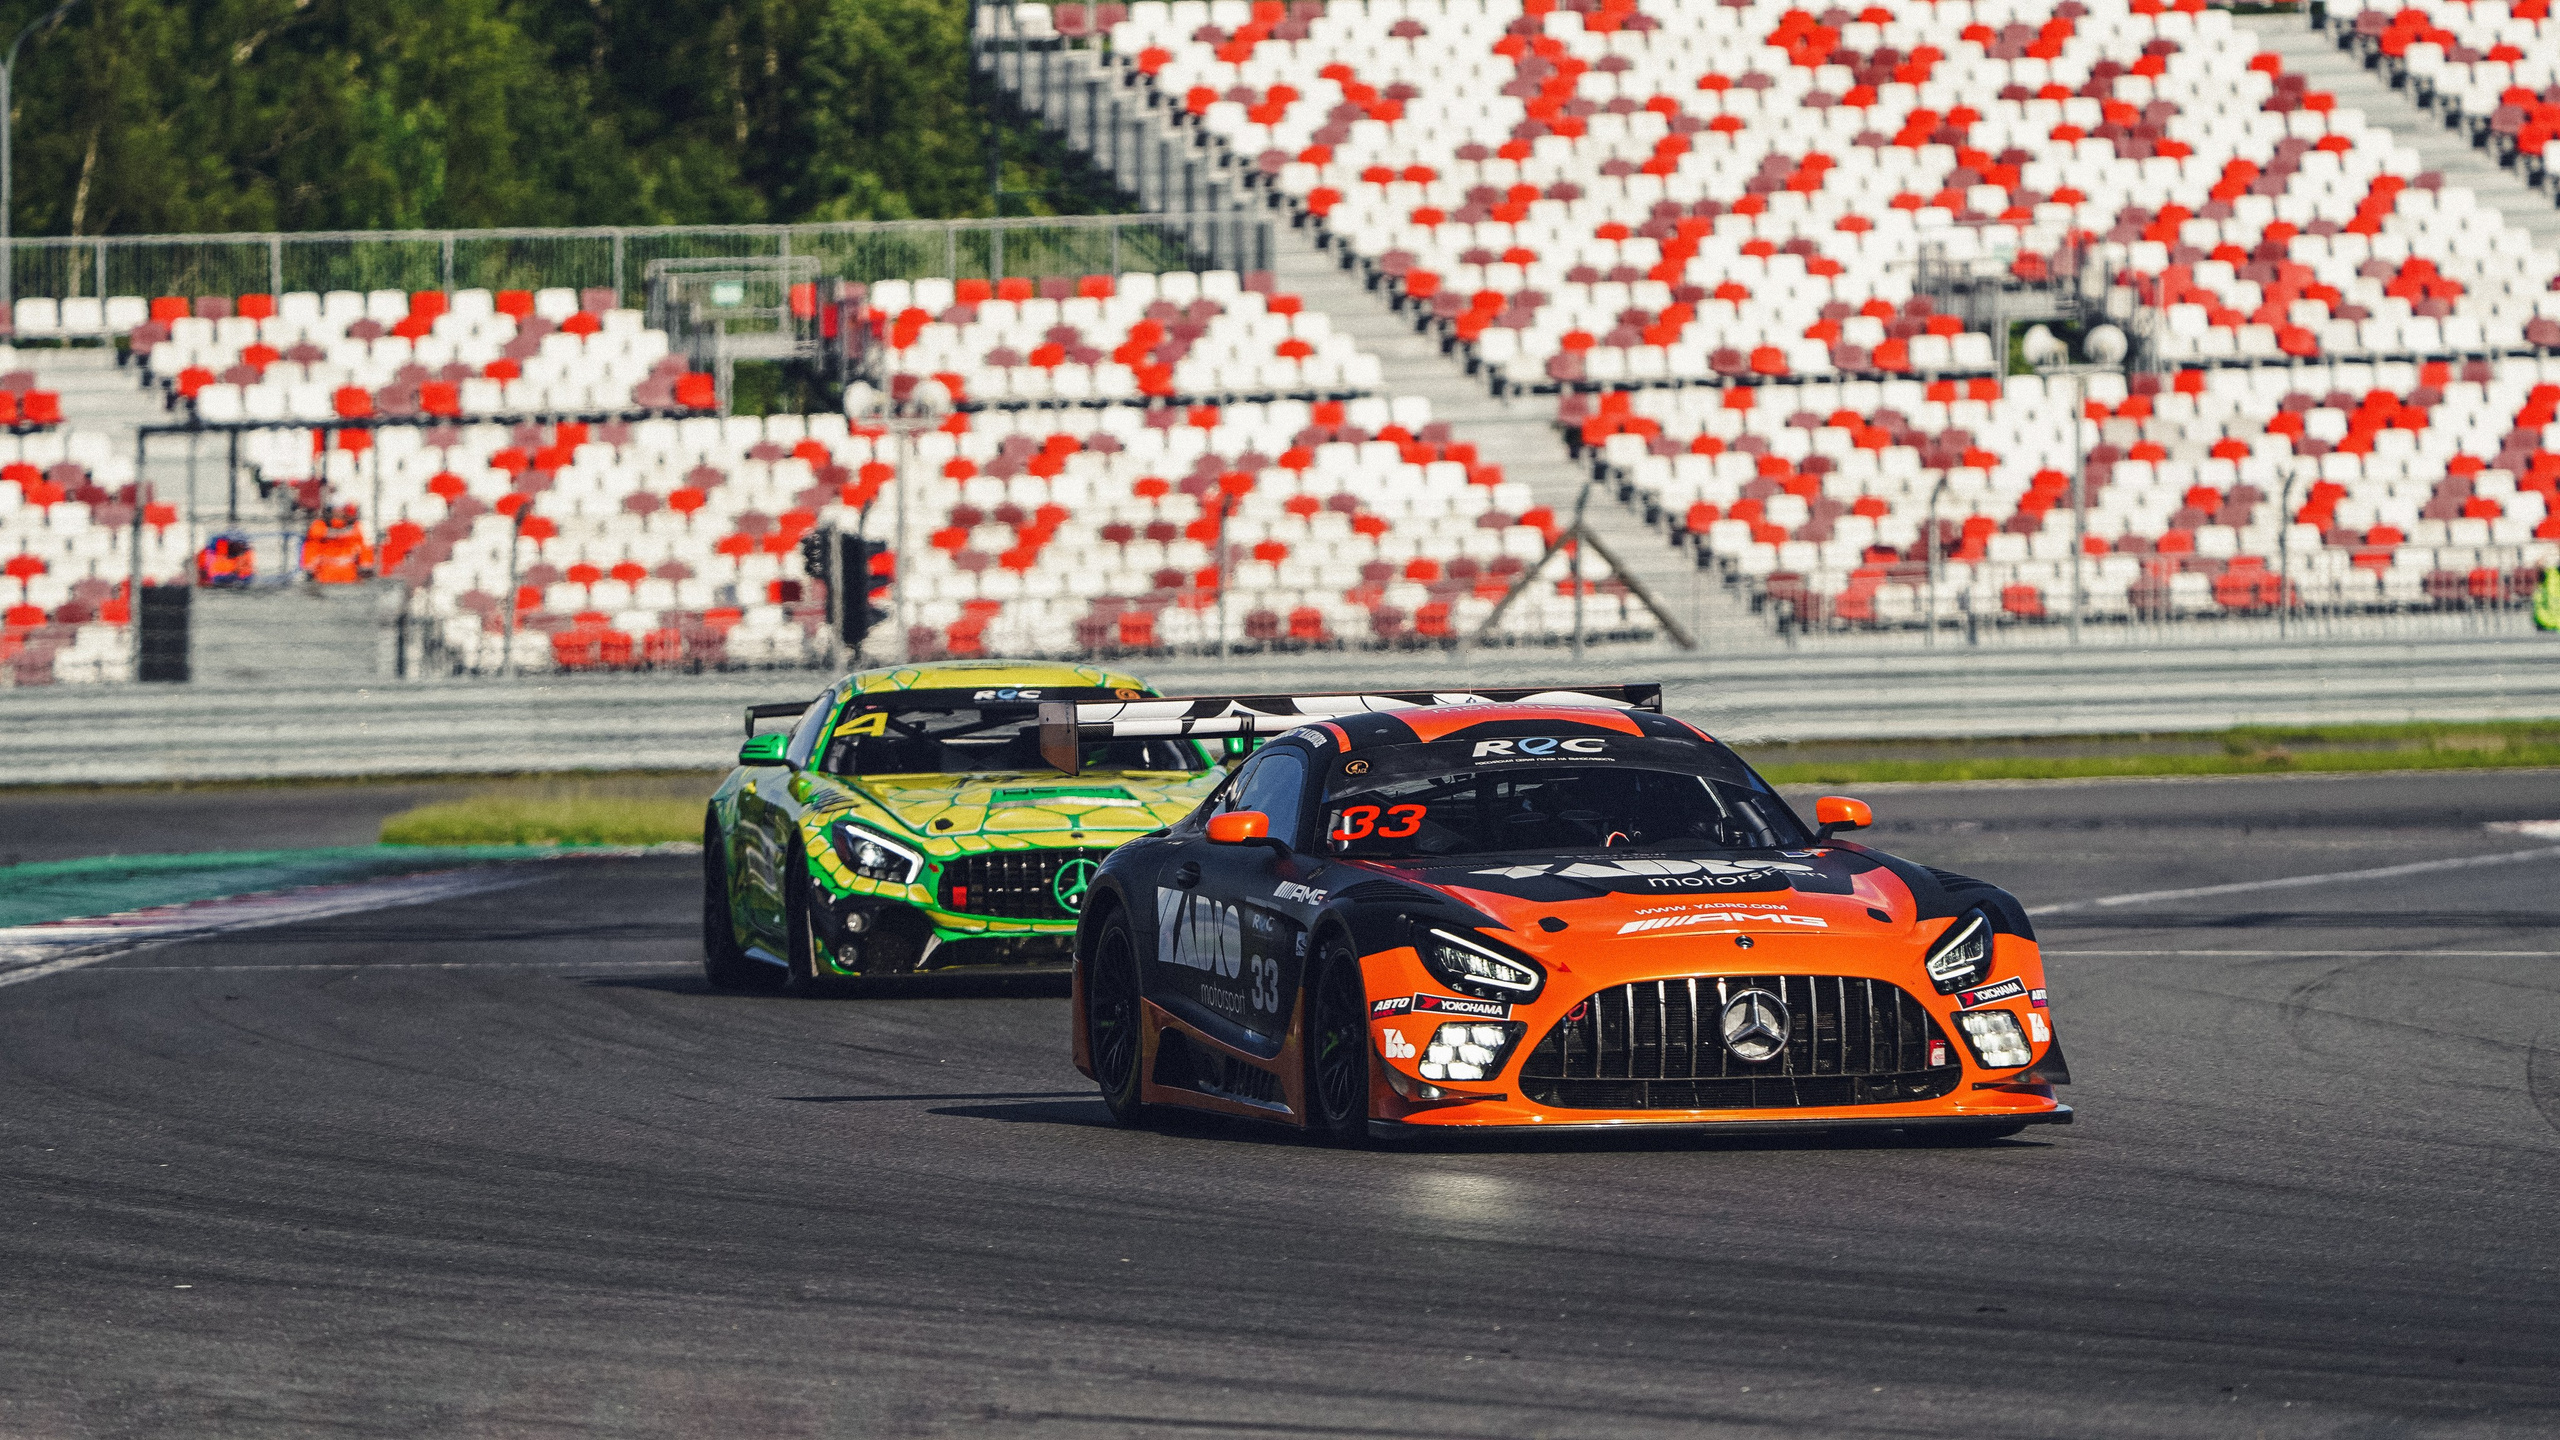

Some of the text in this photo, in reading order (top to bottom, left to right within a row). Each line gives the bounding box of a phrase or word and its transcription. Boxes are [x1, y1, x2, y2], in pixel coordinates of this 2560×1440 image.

[833, 712, 888, 737] 4
[1332, 804, 1427, 840] 33
[1288, 885, 1328, 905] AMG
[1687, 912, 1828, 928] AMG
[1251, 954, 1279, 1014] 33
[1974, 982, 2021, 1001] YOKOHAMA
[1200, 982, 1246, 1017] motorsport
[1441, 1001, 1503, 1015] YOKOHAMA
